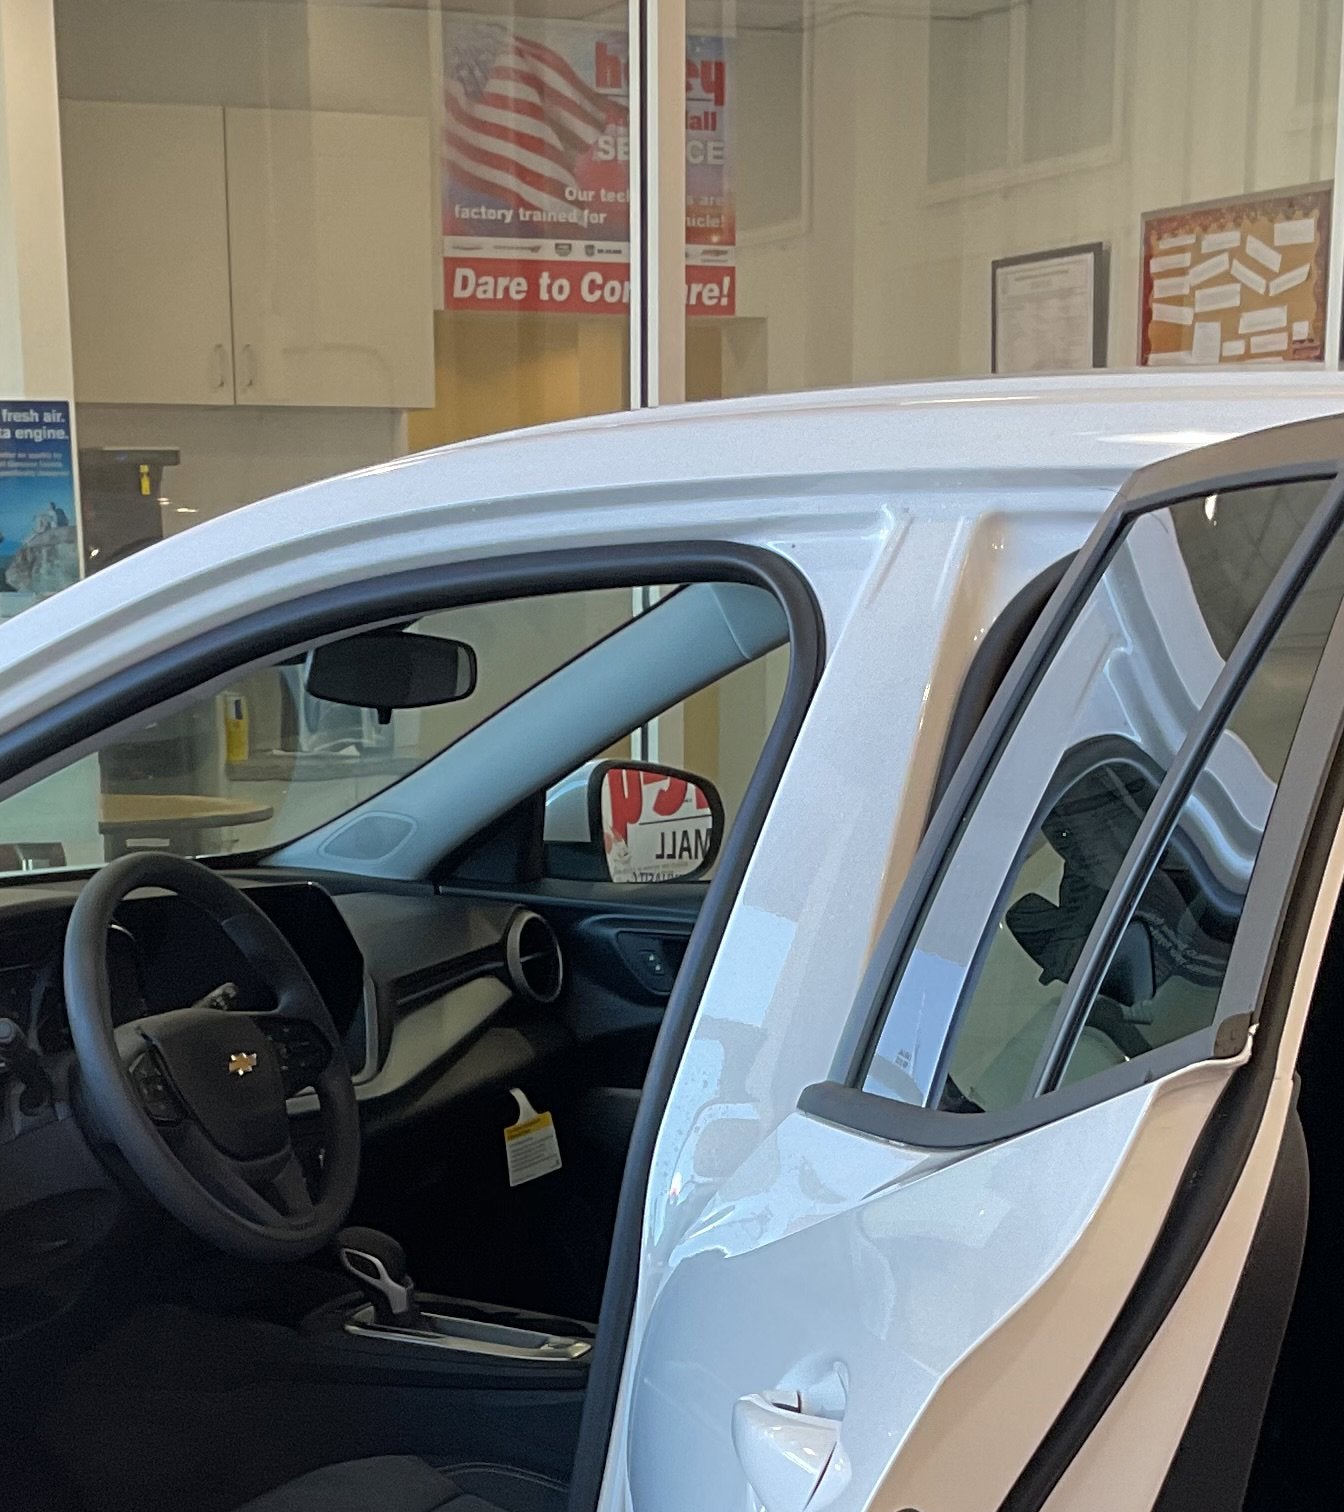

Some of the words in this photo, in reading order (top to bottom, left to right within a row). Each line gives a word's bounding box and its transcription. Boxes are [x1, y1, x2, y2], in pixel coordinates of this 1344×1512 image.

[564, 187, 596, 202] Our
[454, 204, 514, 223] factory
[519, 208, 578, 224] trained
[583, 209, 608, 228] for
[453, 267, 528, 300] Dare
[538, 271, 571, 301] to
[2, 408, 39, 423] fresh
[43, 410, 66, 423] air.
[15, 427, 69, 443] engine.
